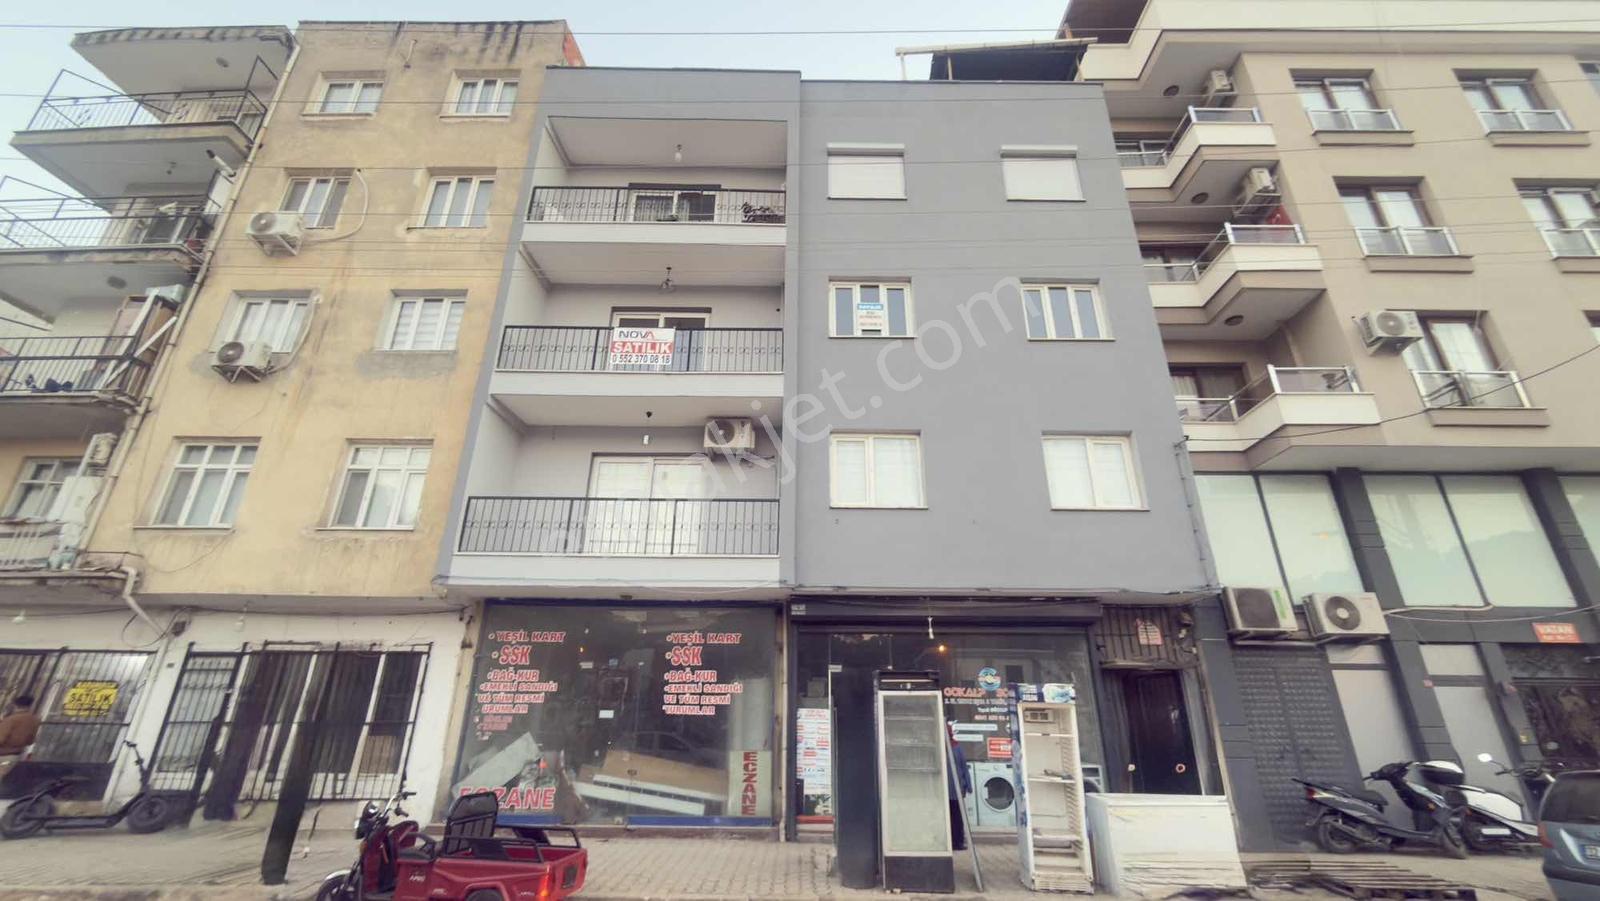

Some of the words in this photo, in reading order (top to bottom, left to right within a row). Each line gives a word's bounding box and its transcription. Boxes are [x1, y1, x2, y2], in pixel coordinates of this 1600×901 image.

[618, 330, 655, 340] NOVA
[613, 341, 671, 353] SATILIK
[619, 354, 633, 363] 552
[634, 354, 648, 363] 370
[496, 629, 530, 643] YEŞİL
[531, 631, 566, 642] KART
[671, 631, 705, 645] YEŞİL
[707, 632, 742, 644] KART
[499, 644, 532, 665] SSK
[671, 646, 703, 666] SSK
[490, 667, 540, 681] BAĞ-KUR
[669, 667, 717, 682] BAĞ-KUR
[667, 682, 702, 693] EMEKLİ
[678, 693, 700, 704] TÜM
[742, 751, 758, 816] ECZANE
